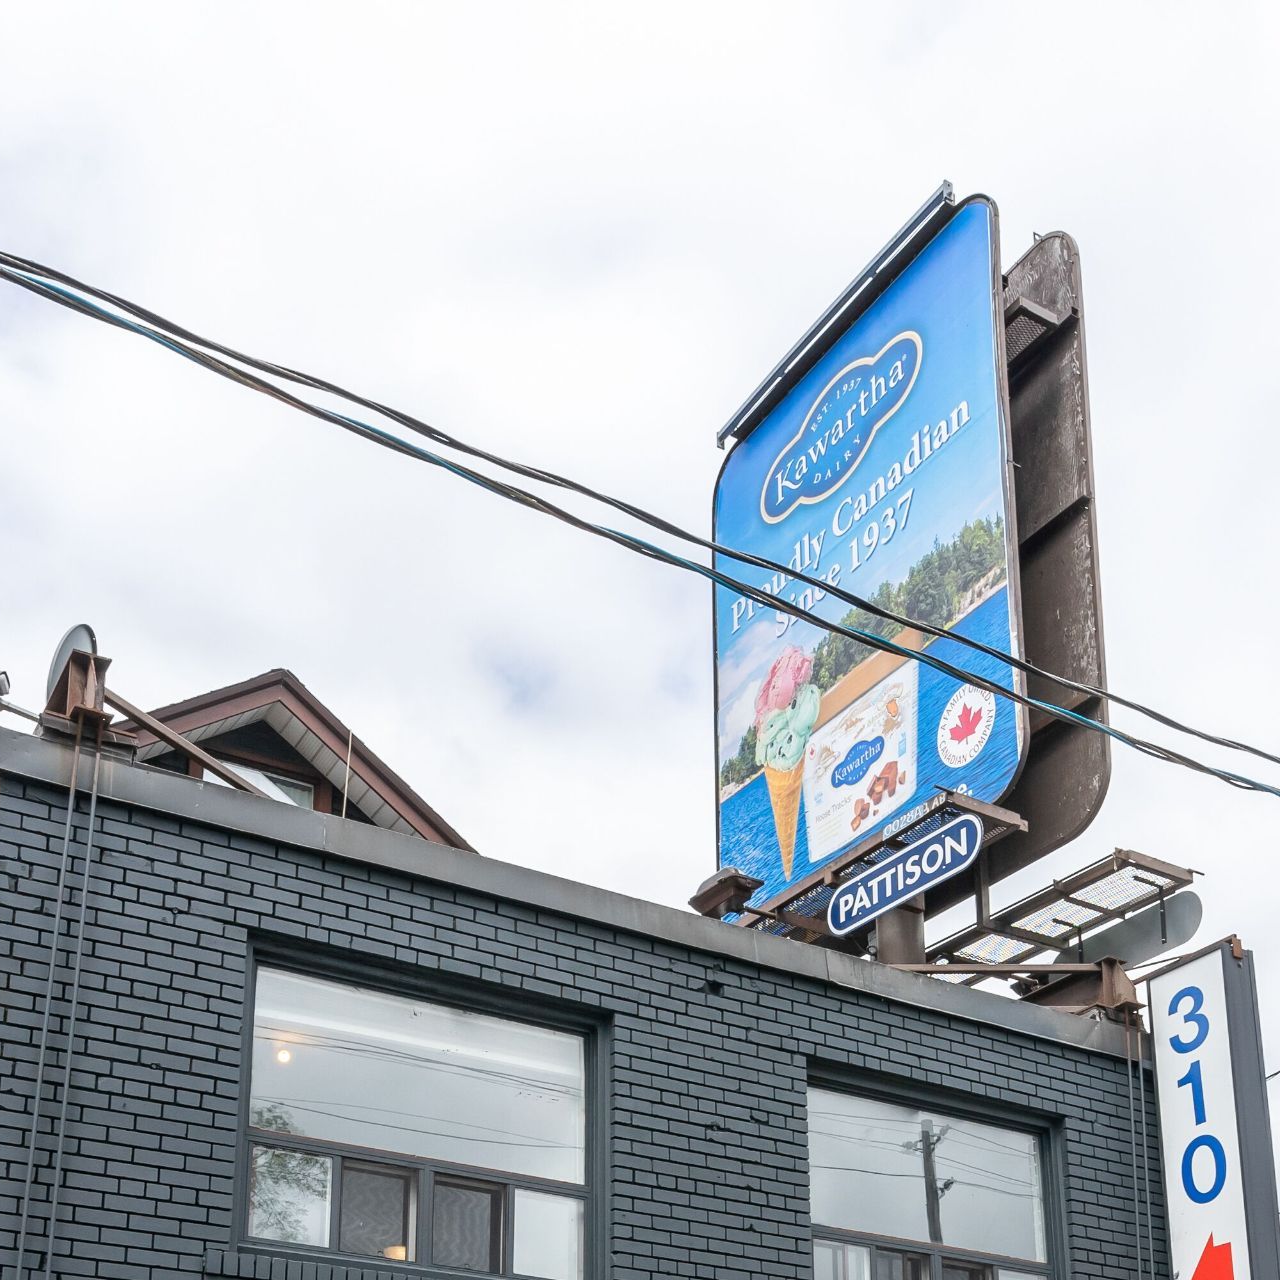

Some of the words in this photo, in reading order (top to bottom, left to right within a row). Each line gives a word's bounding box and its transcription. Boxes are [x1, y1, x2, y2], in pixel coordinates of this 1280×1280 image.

[775, 360, 905, 506] Kawartha
[835, 377, 862, 399] 1937
[813, 433, 861, 484] DAIRY
[731, 528, 826, 635] Proudly
[831, 400, 972, 537] Canadian
[775, 562, 842, 638] Since
[849, 487, 915, 574] 1937
[835, 741, 882, 784] Kawartha
[939, 741, 967, 765] CANADIAN
[969, 709, 995, 758] COMPANY
[839, 827, 968, 923] PATTISON
[1167, 985, 1227, 1204] 310
